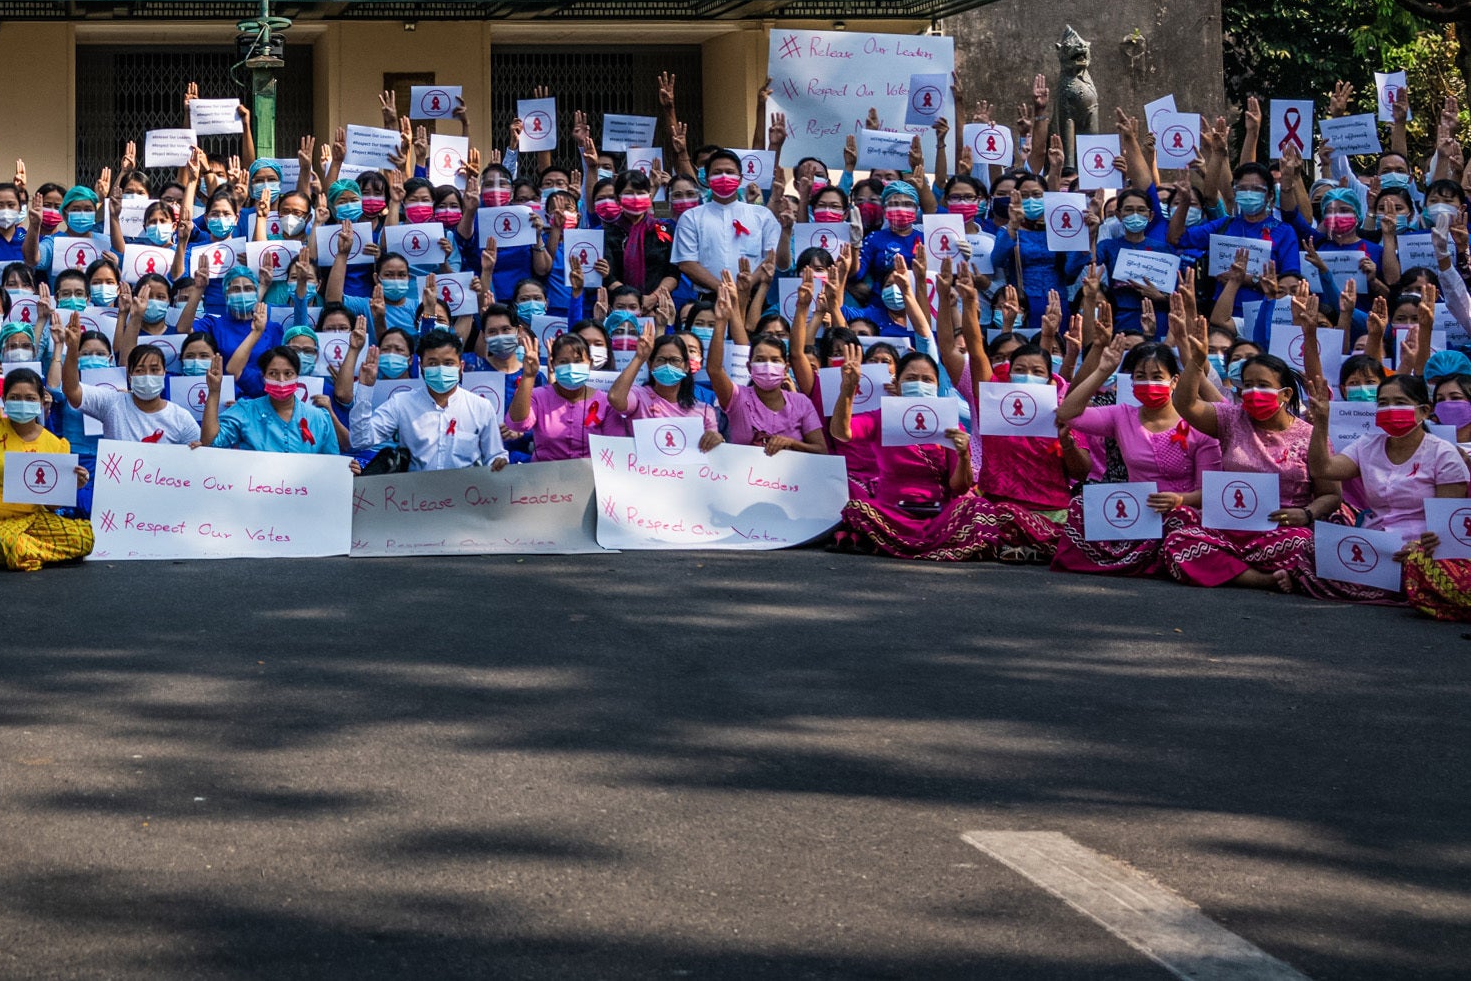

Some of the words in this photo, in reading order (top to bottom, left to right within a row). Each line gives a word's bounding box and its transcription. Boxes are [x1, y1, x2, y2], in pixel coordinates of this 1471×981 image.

[778, 34, 801, 59] #
[809, 36, 854, 59] Release
[863, 37, 886, 55] Our
[897, 41, 933, 60] Leaders
[807, 78, 848, 103] Respect
[855, 84, 874, 97] Our
[806, 119, 841, 139] Reject
[100, 452, 123, 484] #
[131, 458, 191, 489] Release
[203, 476, 234, 491] Our
[247, 475, 309, 496] Leaders
[599, 448, 615, 470] #
[628, 453, 685, 480] Release
[699, 466, 729, 482] Our
[747, 467, 799, 493] Leaders
[384, 485, 456, 513] Release
[464, 485, 498, 506] Our
[509, 485, 573, 505] Leaders
[100, 509, 118, 533] #
[124, 512, 186, 537] Respect
[198, 523, 233, 539] Our
[245, 526, 291, 543] Votes
[601, 495, 620, 524] #
[626, 506, 684, 535] Respect
[692, 524, 720, 537] Our
[730, 524, 788, 543] Votes
